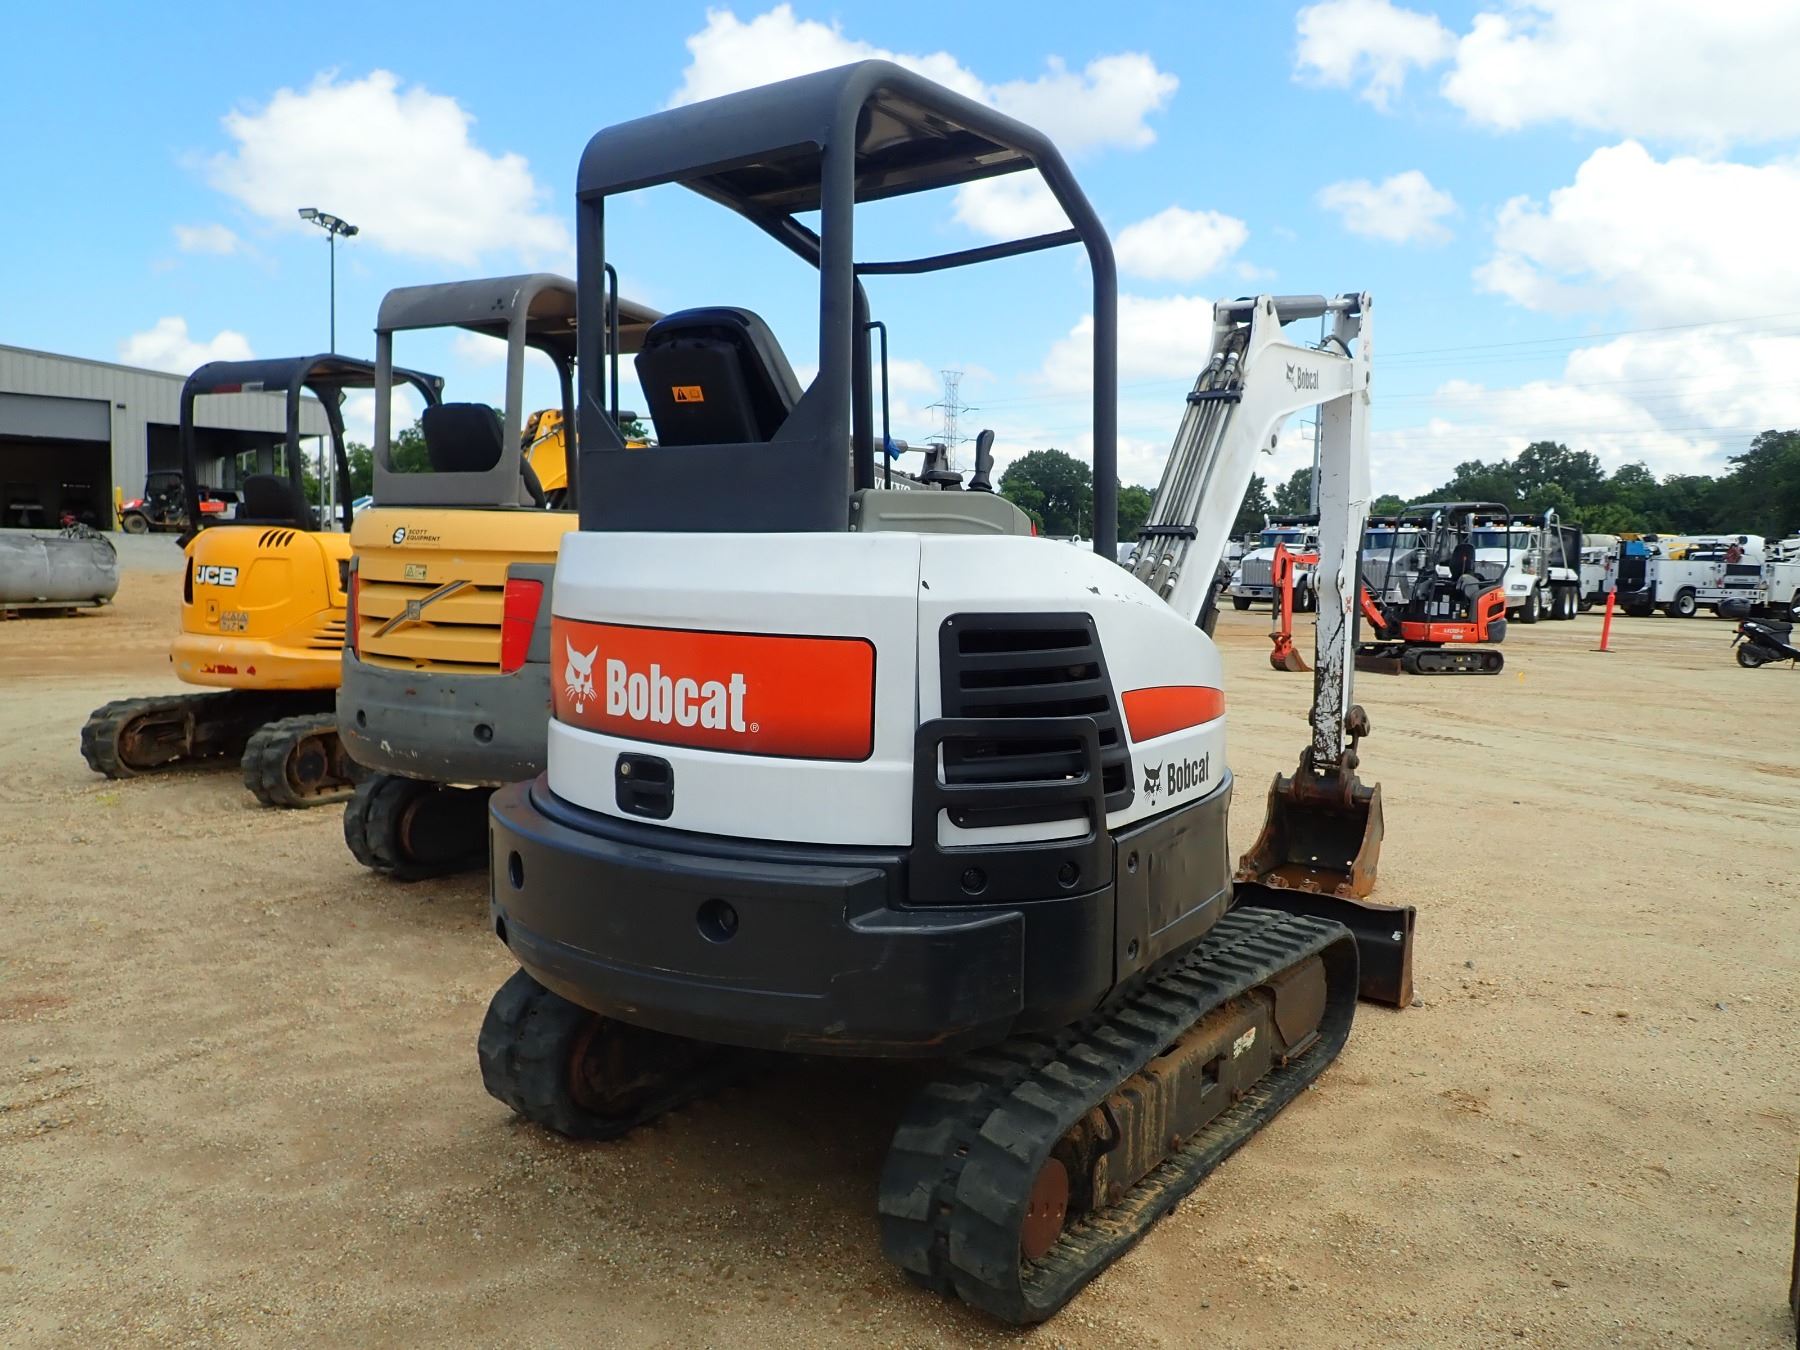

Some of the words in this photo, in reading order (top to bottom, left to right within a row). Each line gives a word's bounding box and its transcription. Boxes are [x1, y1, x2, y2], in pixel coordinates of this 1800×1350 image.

[1297, 366, 1319, 390] Bobcat
[195, 565, 239, 587] JCB
[606, 658, 747, 733] Bobcat
[1167, 751, 1209, 797] Bobcat
